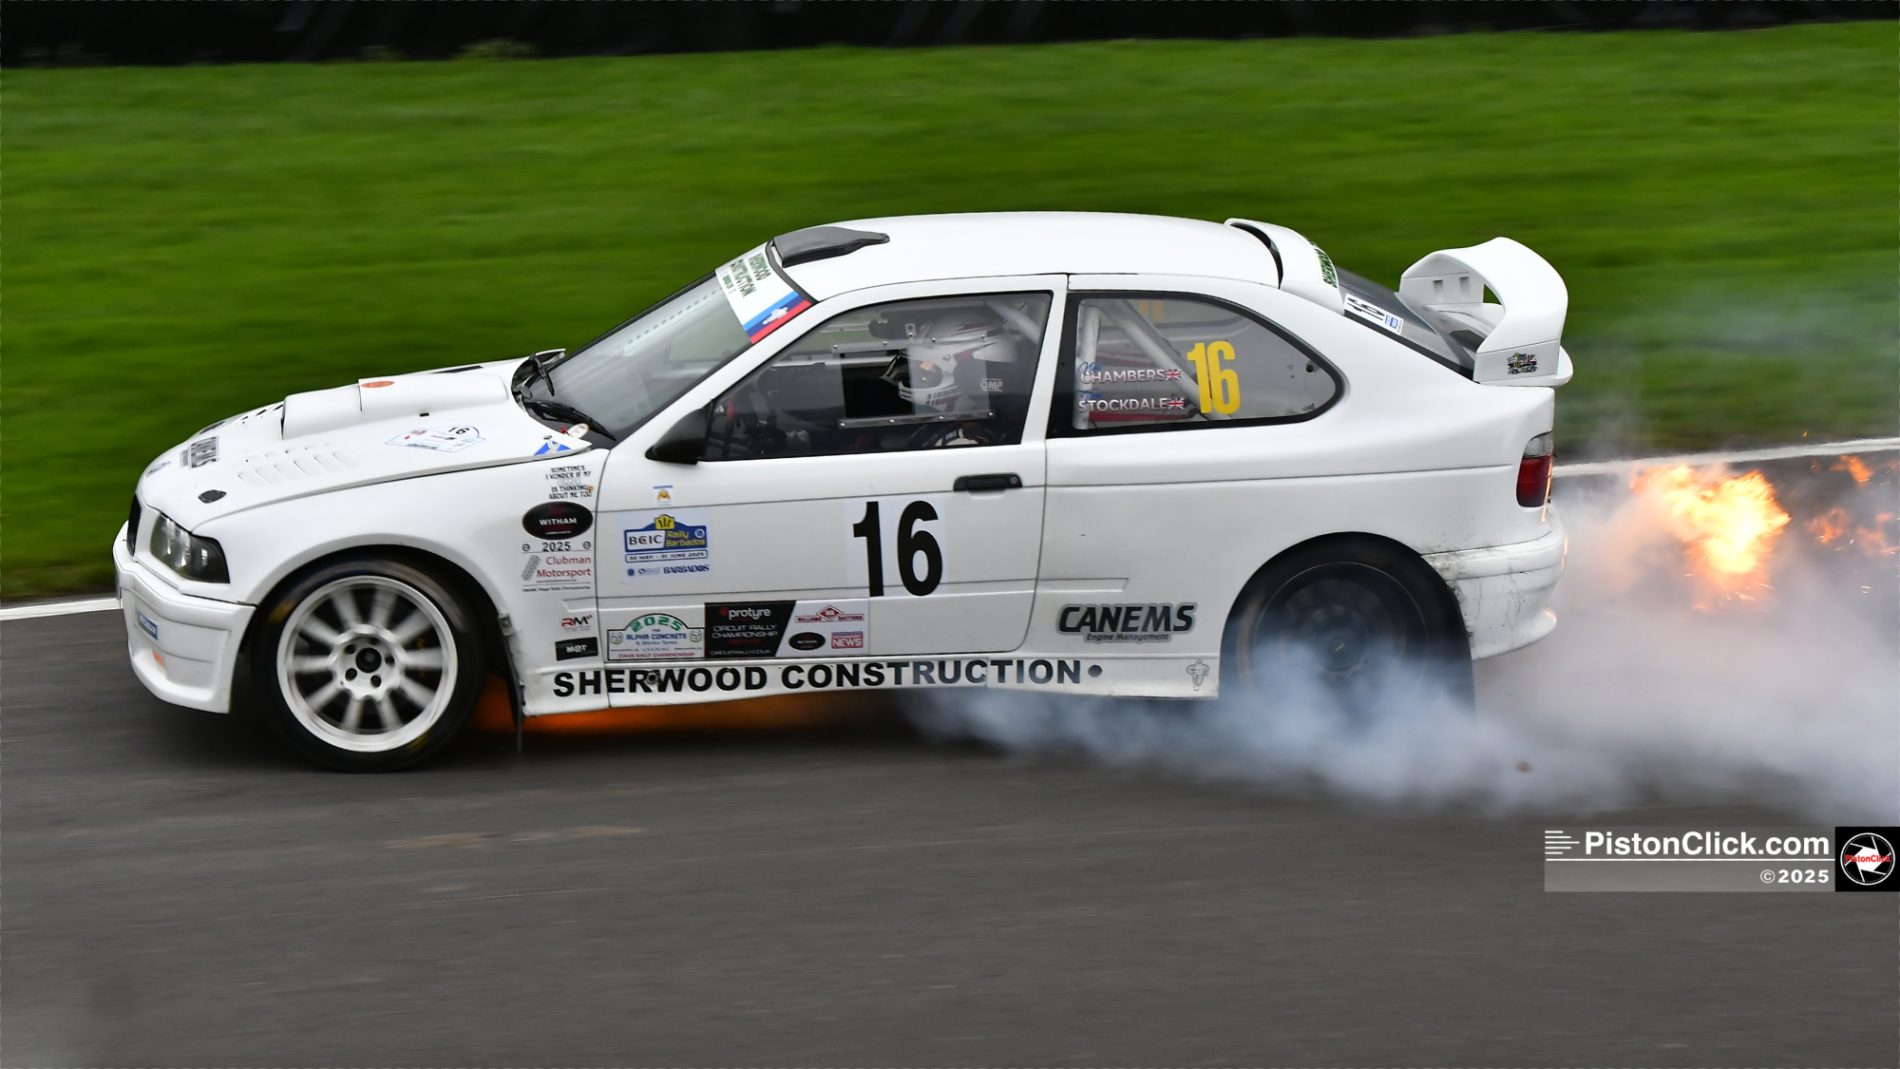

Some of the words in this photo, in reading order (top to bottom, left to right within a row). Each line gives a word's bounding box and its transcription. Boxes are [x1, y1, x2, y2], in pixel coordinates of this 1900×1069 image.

[1081, 369, 1165, 384] CHAMBERS
[1187, 341, 1240, 415] 16
[1079, 397, 1168, 412] STOCKDALE
[539, 517, 578, 526] WITHAM
[666, 530, 689, 539] Rally
[541, 541, 571, 552] 2025
[666, 538, 706, 547] Barbados
[853, 500, 943, 597] 16
[545, 555, 591, 565] Clubman
[536, 568, 592, 578] Motorsport
[663, 564, 710, 574] BARBADOS
[728, 607, 771, 620] protyre
[1059, 605, 1195, 632] CANEMS
[630, 616, 683, 632] 2025
[749, 623, 777, 631] RALLY
[651, 632, 687, 640] CONCRETE
[712, 631, 778, 639] CHAMPIONSHIP
[1086, 633, 1113, 641] Engine
[1116, 633, 1170, 641] Management
[832, 638, 862, 647] NEWS
[553, 666, 767, 697] SHERWOOD
[781, 659, 1081, 689] CONSTRUCTION
